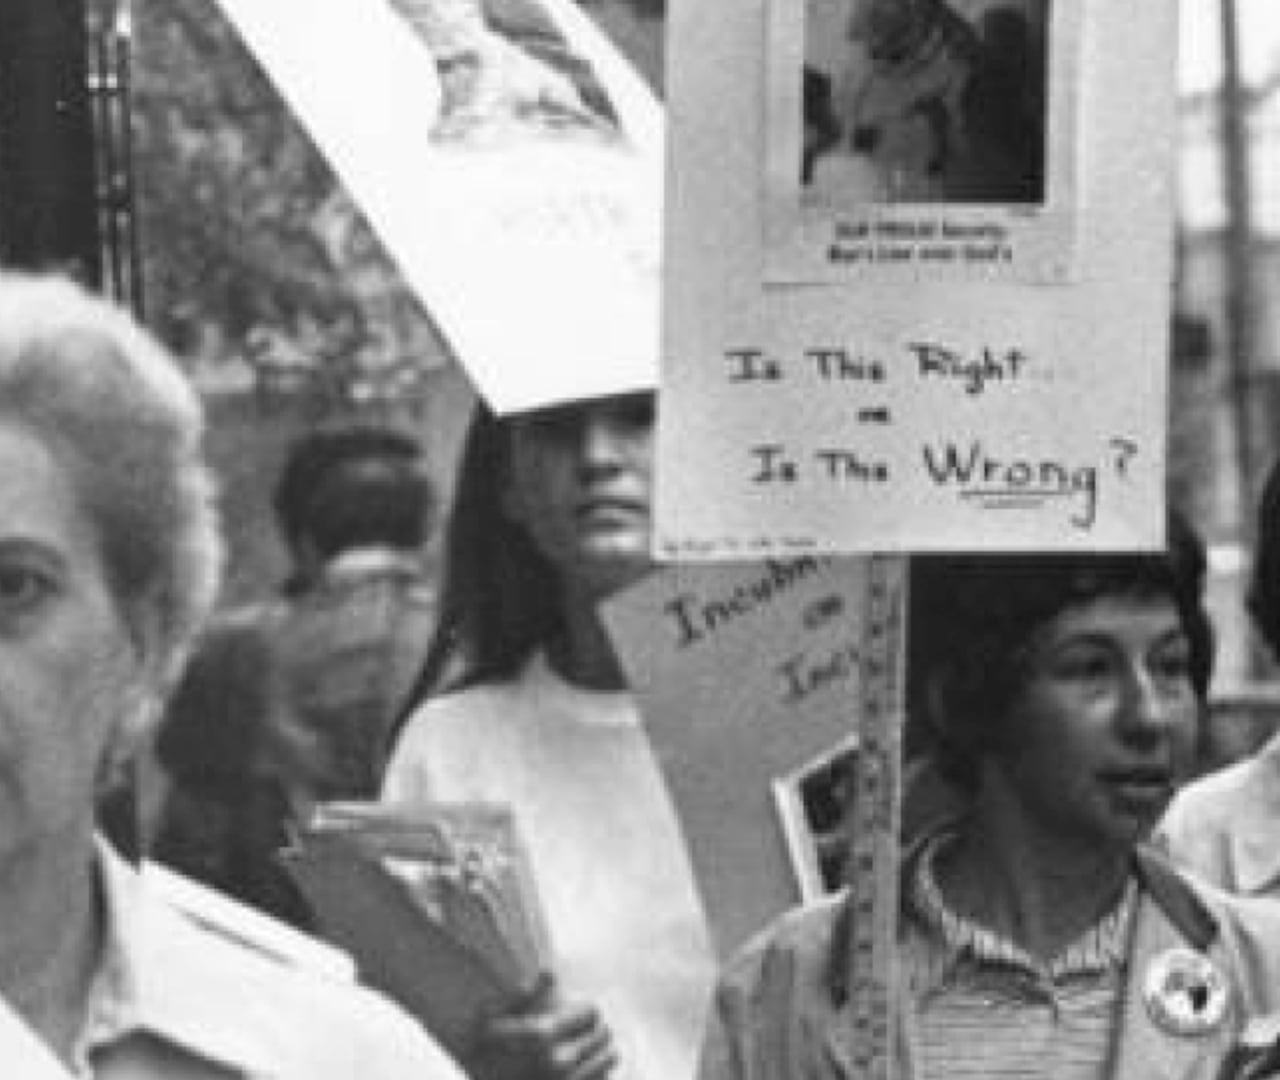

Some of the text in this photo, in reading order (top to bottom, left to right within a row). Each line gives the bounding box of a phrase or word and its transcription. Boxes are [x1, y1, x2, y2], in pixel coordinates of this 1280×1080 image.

[723, 348, 783, 384] Is
[803, 347, 888, 384] This
[749, 444, 799, 485] Is
